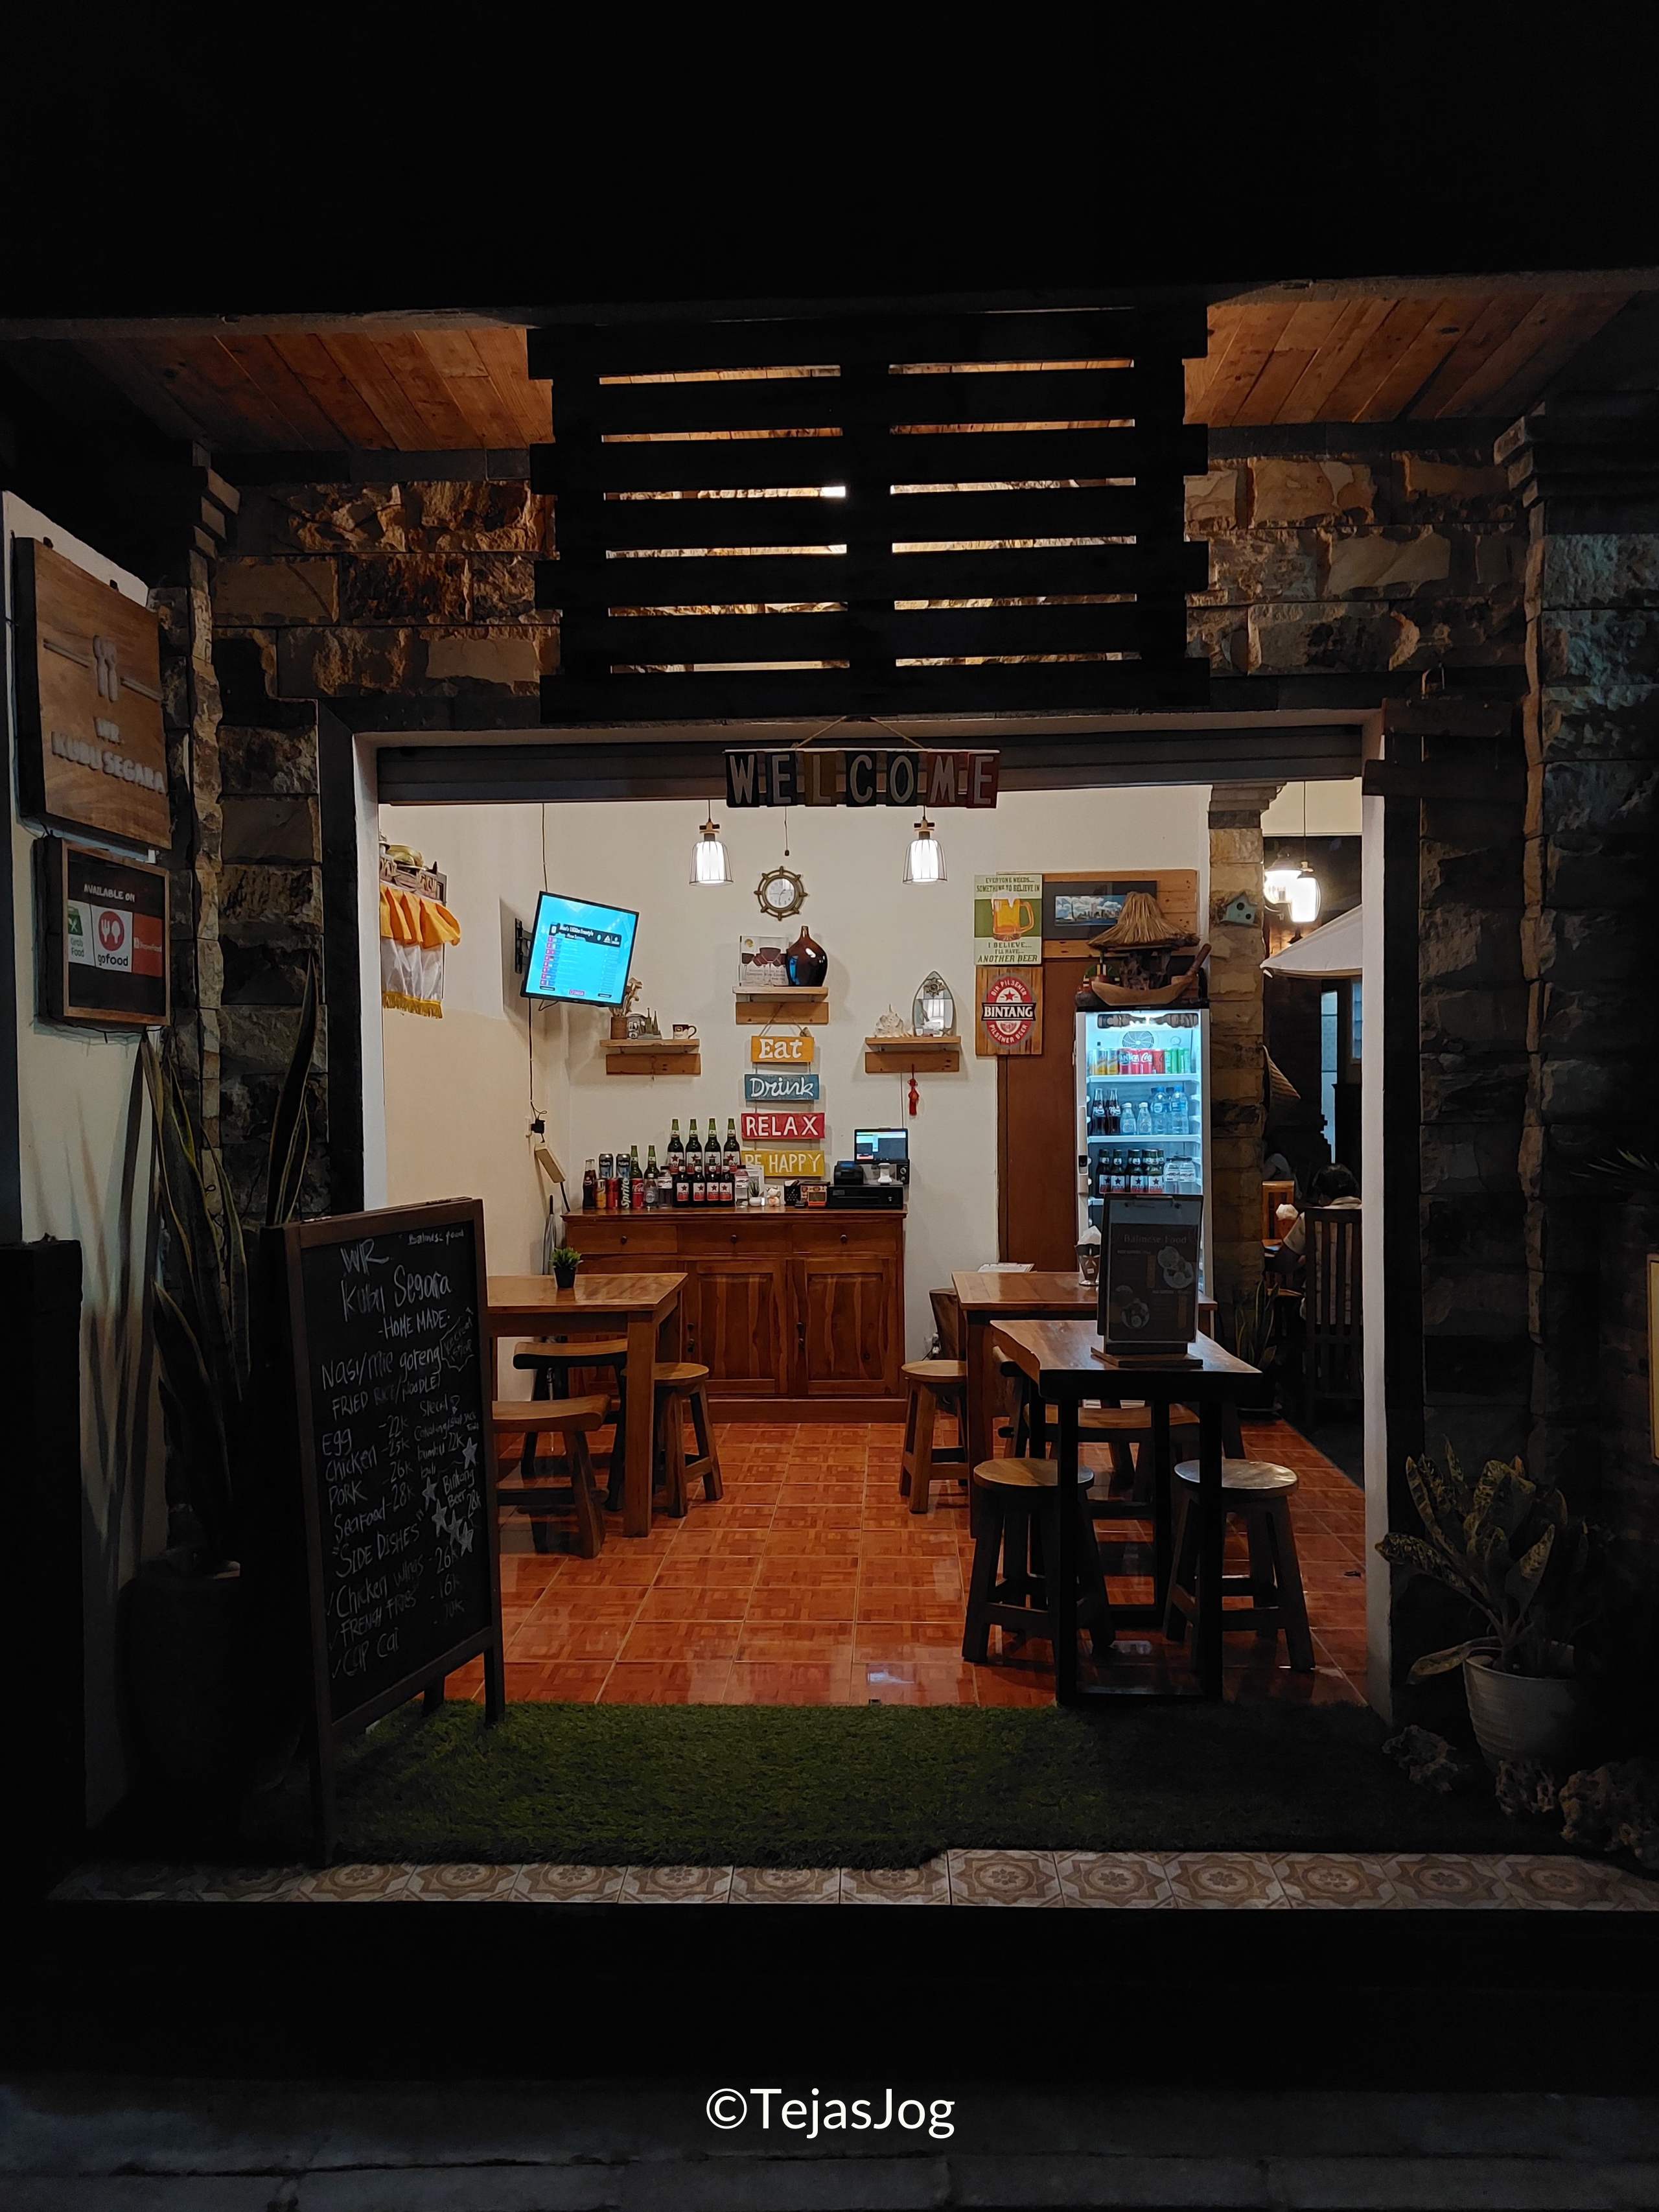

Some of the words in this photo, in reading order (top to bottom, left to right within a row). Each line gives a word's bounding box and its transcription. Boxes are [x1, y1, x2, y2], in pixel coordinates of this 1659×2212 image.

[102, 751, 165, 794] SEGARA
[729, 754, 994, 804] WELCOME
[84, 883, 124, 901] AVAILABLE
[125, 891, 135, 903] ON
[71, 948, 84, 958] Food
[98, 954, 128, 966] gofood
[978, 955, 1015, 963] ANOTHER
[1000, 979, 1027, 996] PILSENER
[984, 1006, 1033, 1018] BINTANG
[989, 1024, 1015, 1043] PILSENER
[759, 1038, 803, 1058] Eat
[749, 1077, 814, 1097] Drink
[746, 1116, 819, 1136] RELAX
[769, 1154, 822, 1174] HAPPY
[621, 1178, 631, 1208] Sprite
[1124, 1234, 1162, 1243] Balinese
[1165, 1235, 1187, 1244] Food
[332, 1391, 369, 1421] FRIED
[323, 1428, 353, 1456] Egg
[443, 1467, 474, 1496] Bintang
[336, 1576, 388, 1618] Chicken
